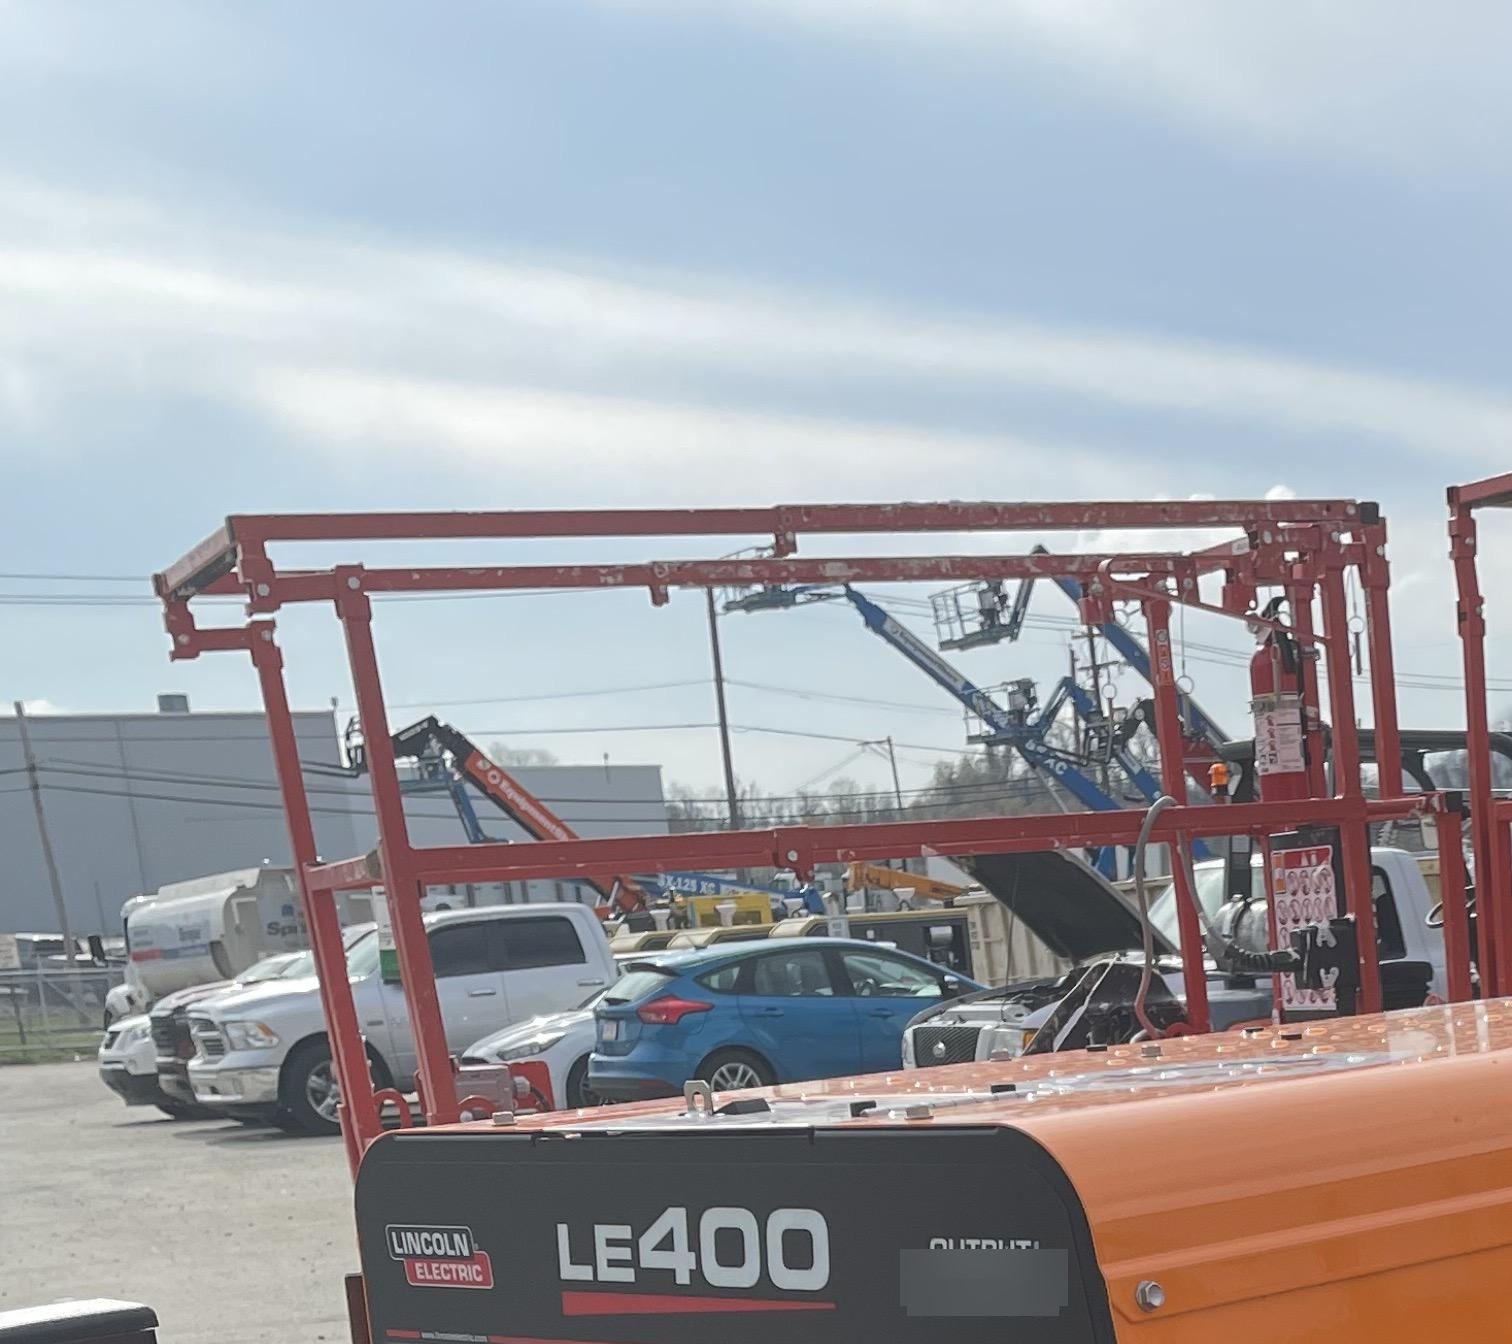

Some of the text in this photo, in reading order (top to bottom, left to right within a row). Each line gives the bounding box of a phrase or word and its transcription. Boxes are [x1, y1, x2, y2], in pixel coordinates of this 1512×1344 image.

[391, 1231, 470, 1257] LINCOLN
[556, 1206, 831, 1291] LE400
[414, 1262, 483, 1282] ELECTRIC
